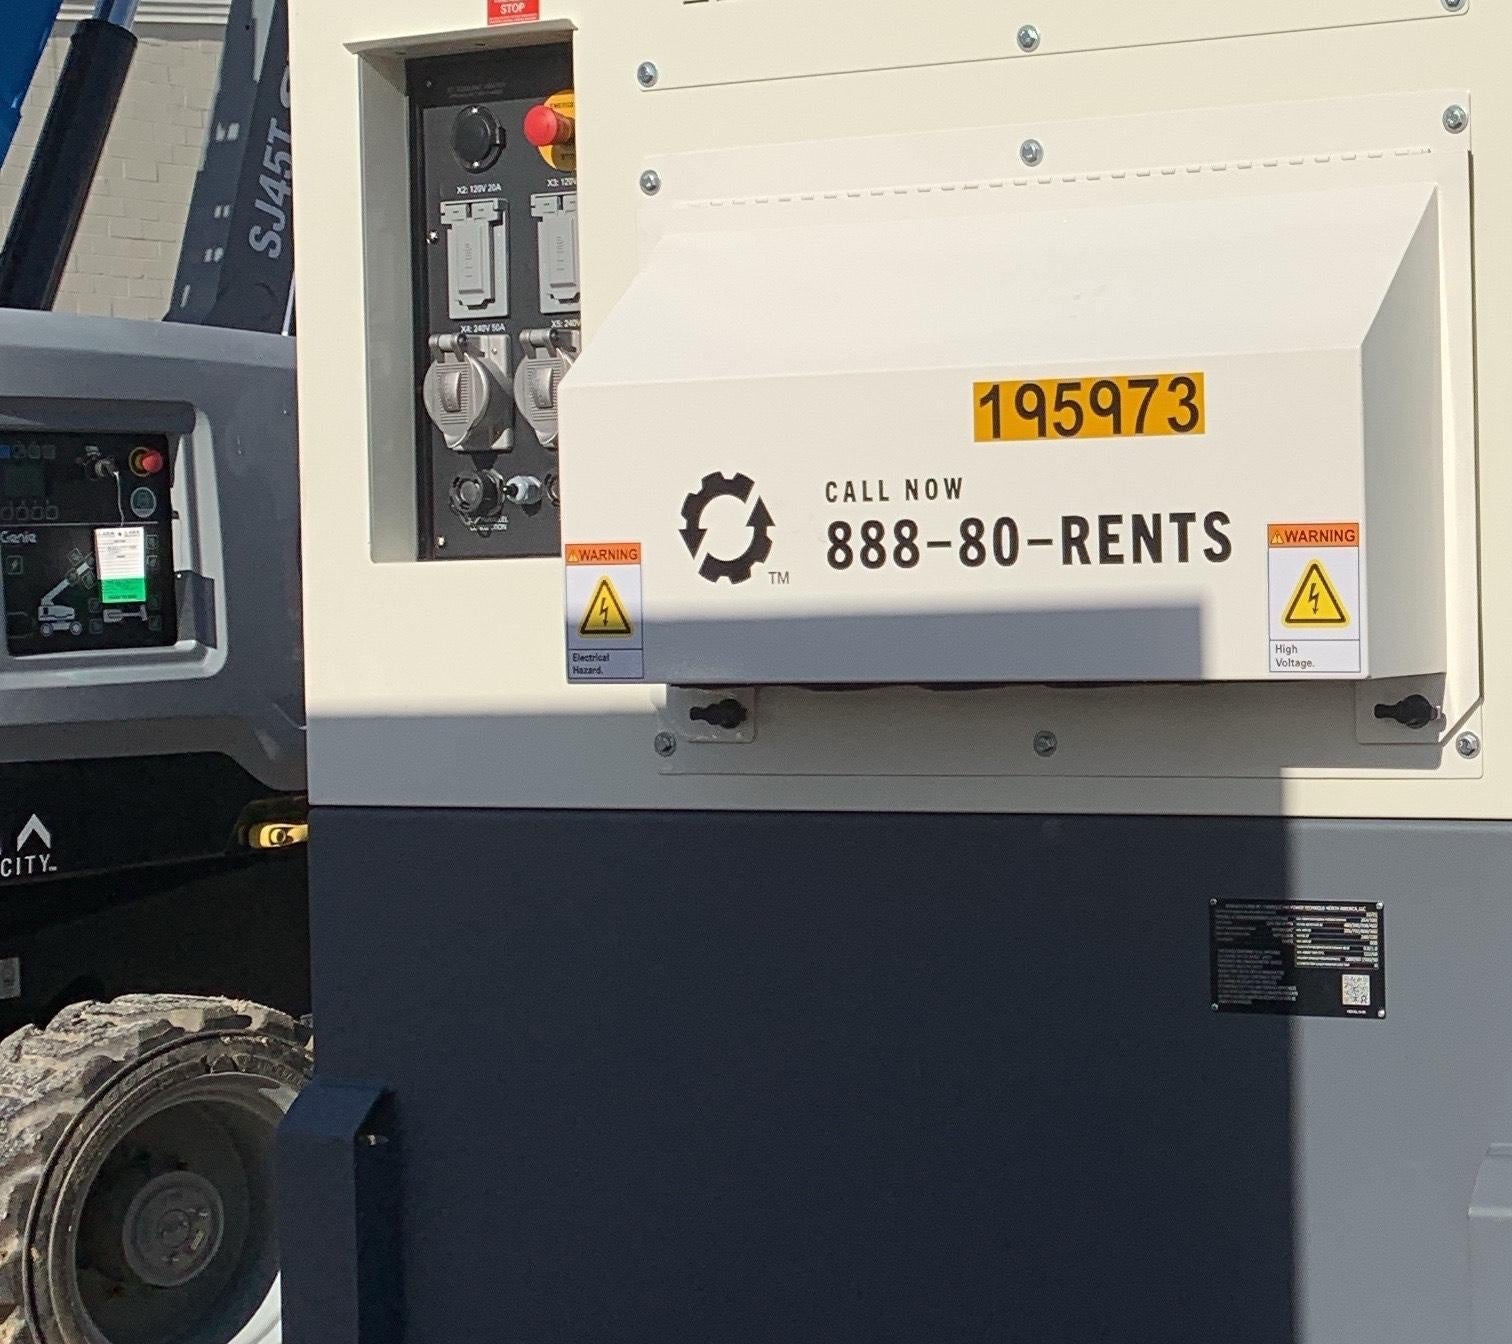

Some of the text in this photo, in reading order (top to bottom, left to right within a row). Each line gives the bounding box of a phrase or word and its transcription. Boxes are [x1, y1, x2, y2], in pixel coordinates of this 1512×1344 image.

[500, 2, 526, 15] STOP
[977, 375, 1200, 440] 195973
[825, 477, 964, 504] CALL NOW
[0, 530, 37, 544] Genie
[826, 510, 1233, 571] 888-80-RENTS
[1284, 529, 1356, 544] WARNING
[578, 548, 638, 563] WARNING
[1275, 643, 1298, 656] High
[572, 652, 610, 663] Electrical
[1275, 657, 1316, 670] Voltage.
[572, 666, 604, 675] Hazard.
